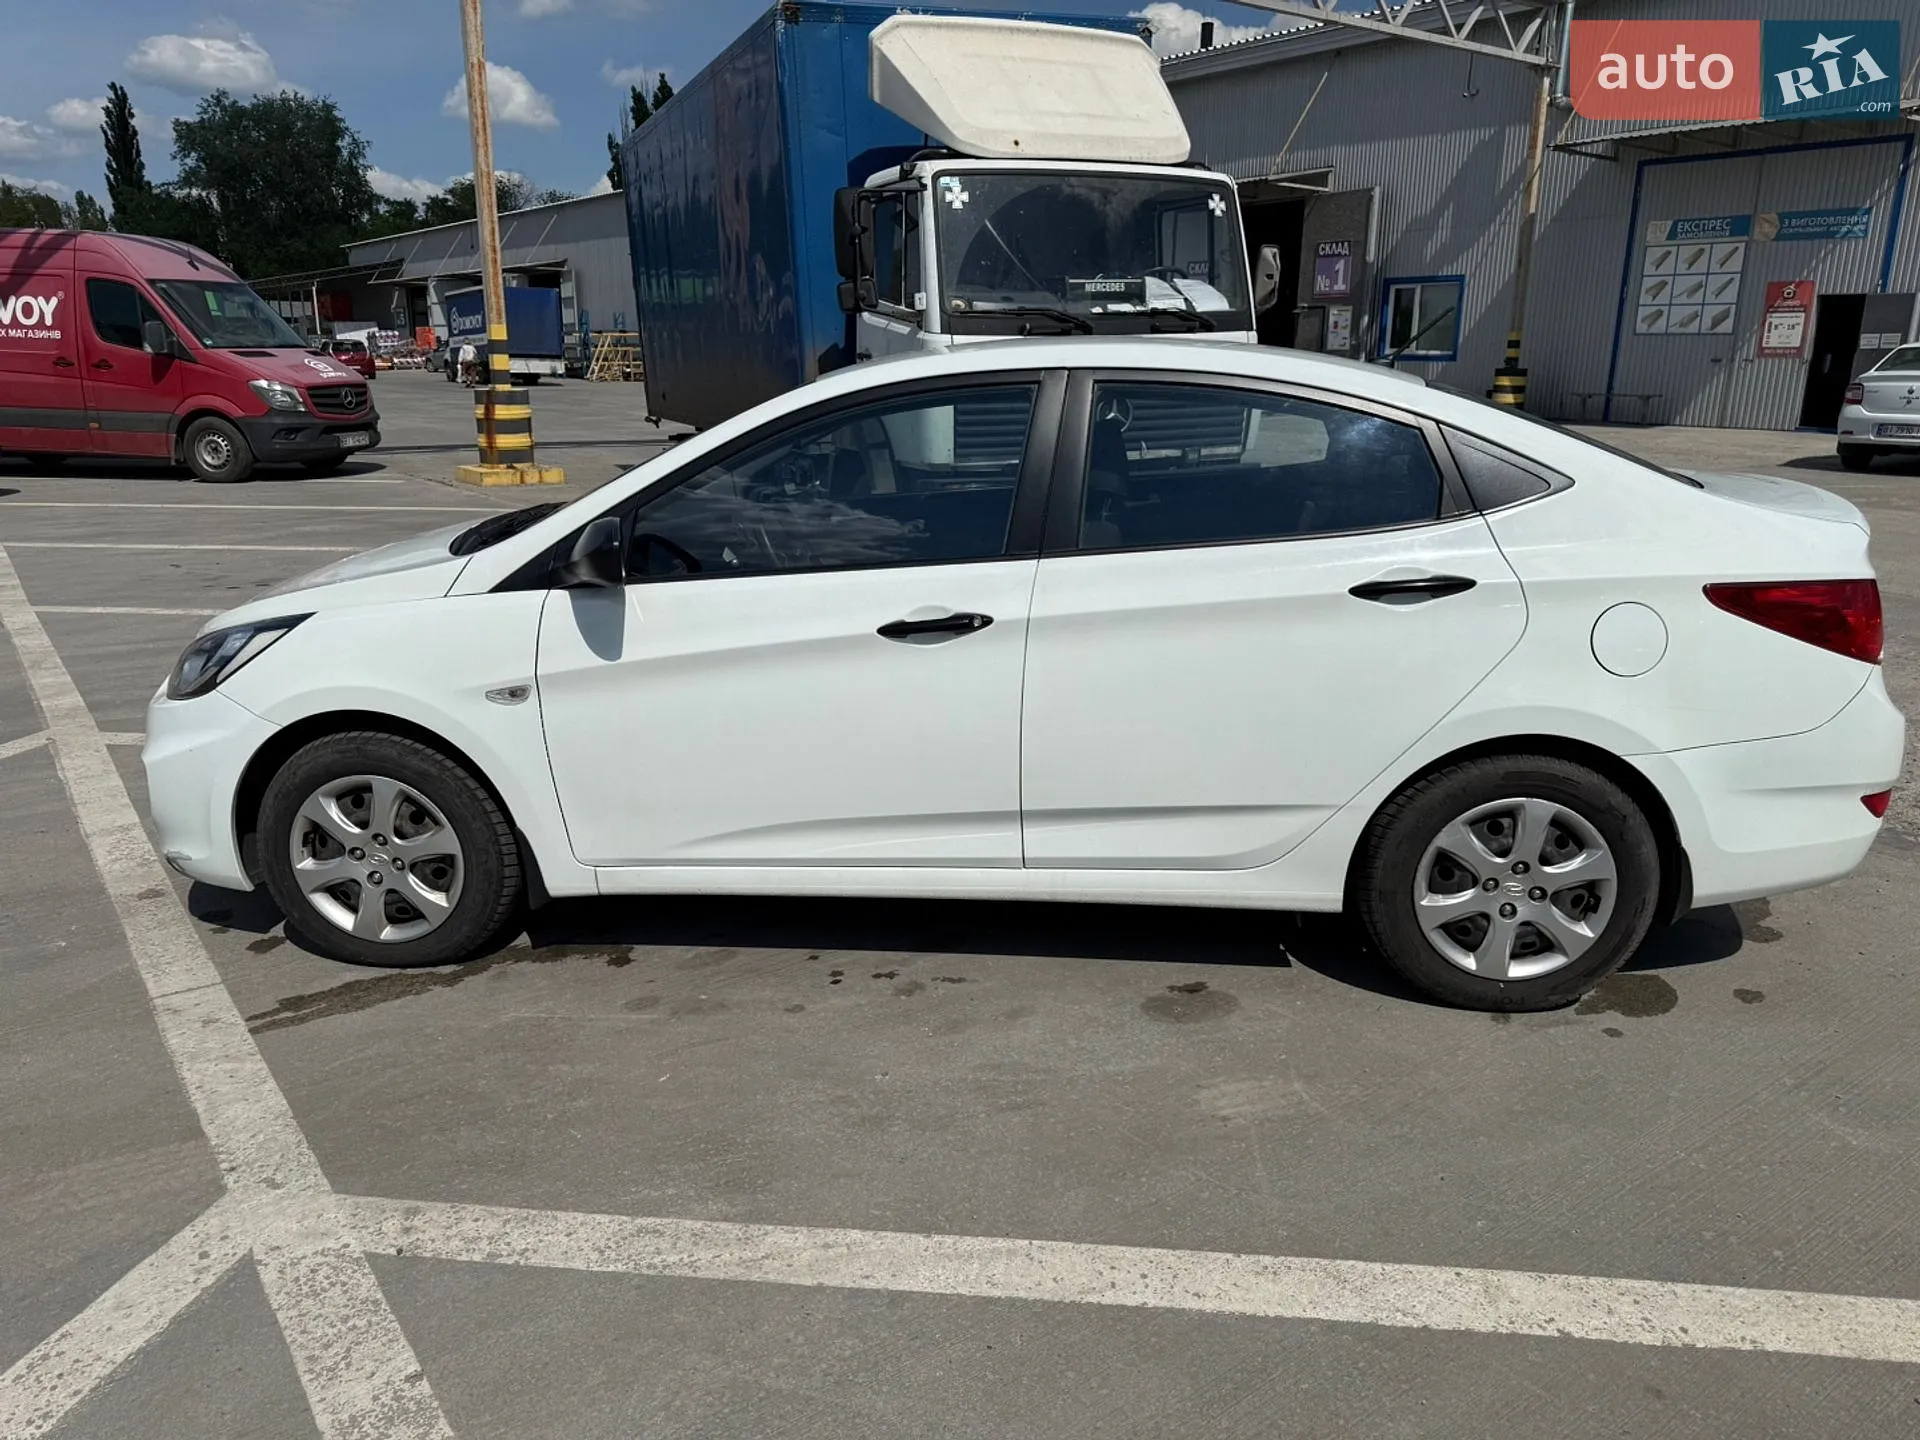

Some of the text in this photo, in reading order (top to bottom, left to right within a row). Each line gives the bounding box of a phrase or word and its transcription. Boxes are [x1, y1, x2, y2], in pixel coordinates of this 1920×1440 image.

[1676, 218, 1732, 232] ЕКСПРЕС
[1318, 241, 1350, 256] СКЛАД
[1084, 282, 1126, 292] MERCEDES
[8, 328, 62, 339] МАГАЗИНІВ
